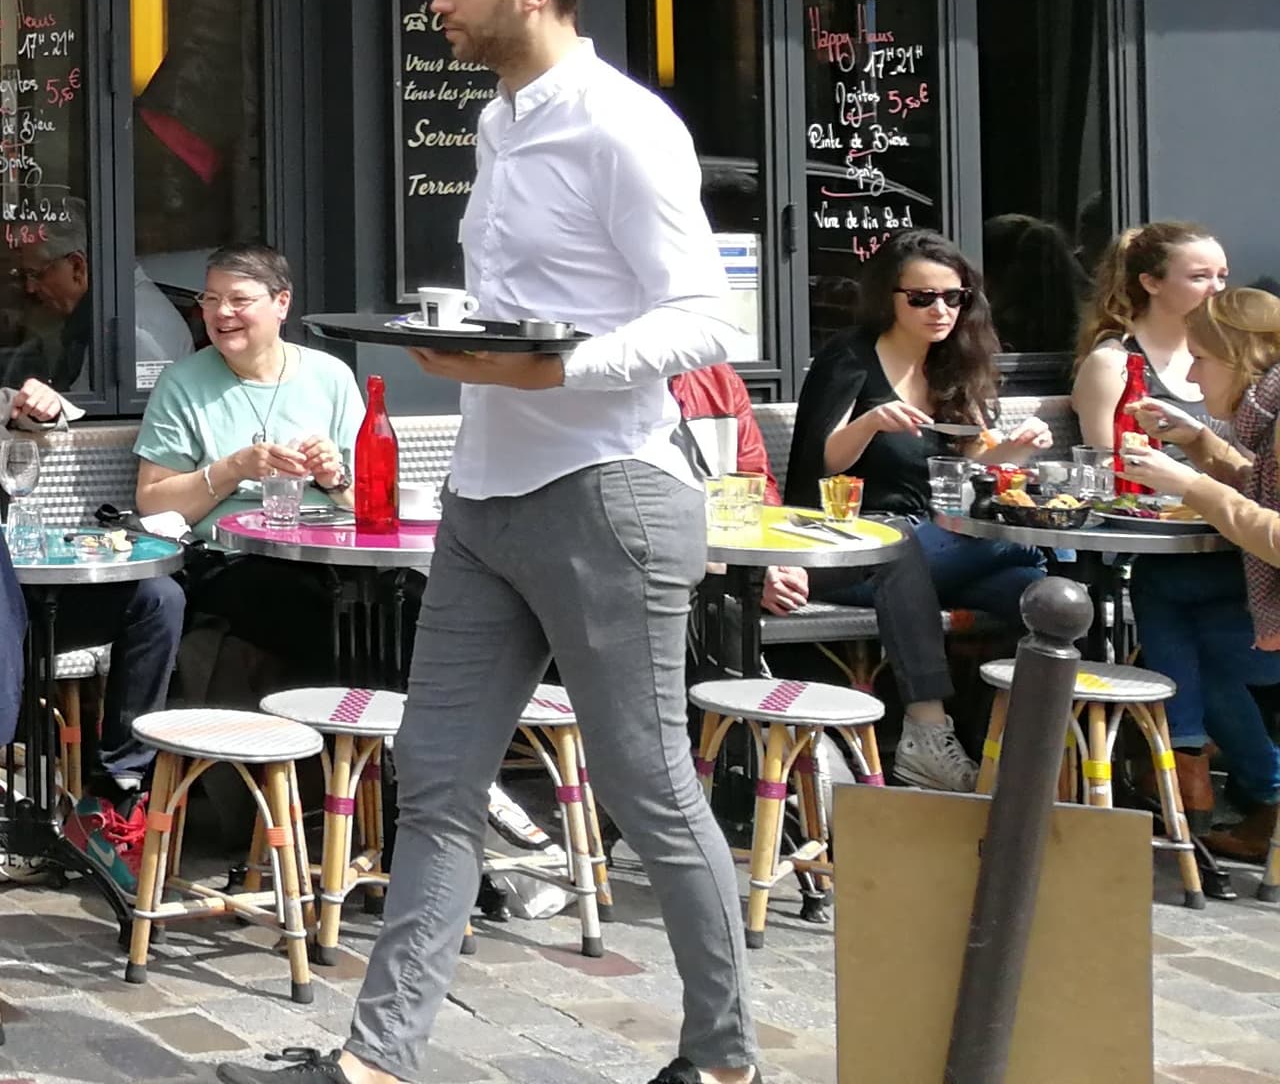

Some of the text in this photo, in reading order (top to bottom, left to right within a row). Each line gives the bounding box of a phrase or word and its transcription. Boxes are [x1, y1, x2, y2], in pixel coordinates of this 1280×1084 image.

[808, 5, 855, 72] Happy
[405, 54, 444, 72] Vous
[403, 80, 437, 101] tous
[438, 81, 458, 101] les
[808, 123, 843, 149] Pinte
[850, 132, 863, 149] de
[20, 198, 38, 221] Vin
[845, 210, 859, 229] de
[862, 205, 879, 229] Vin
